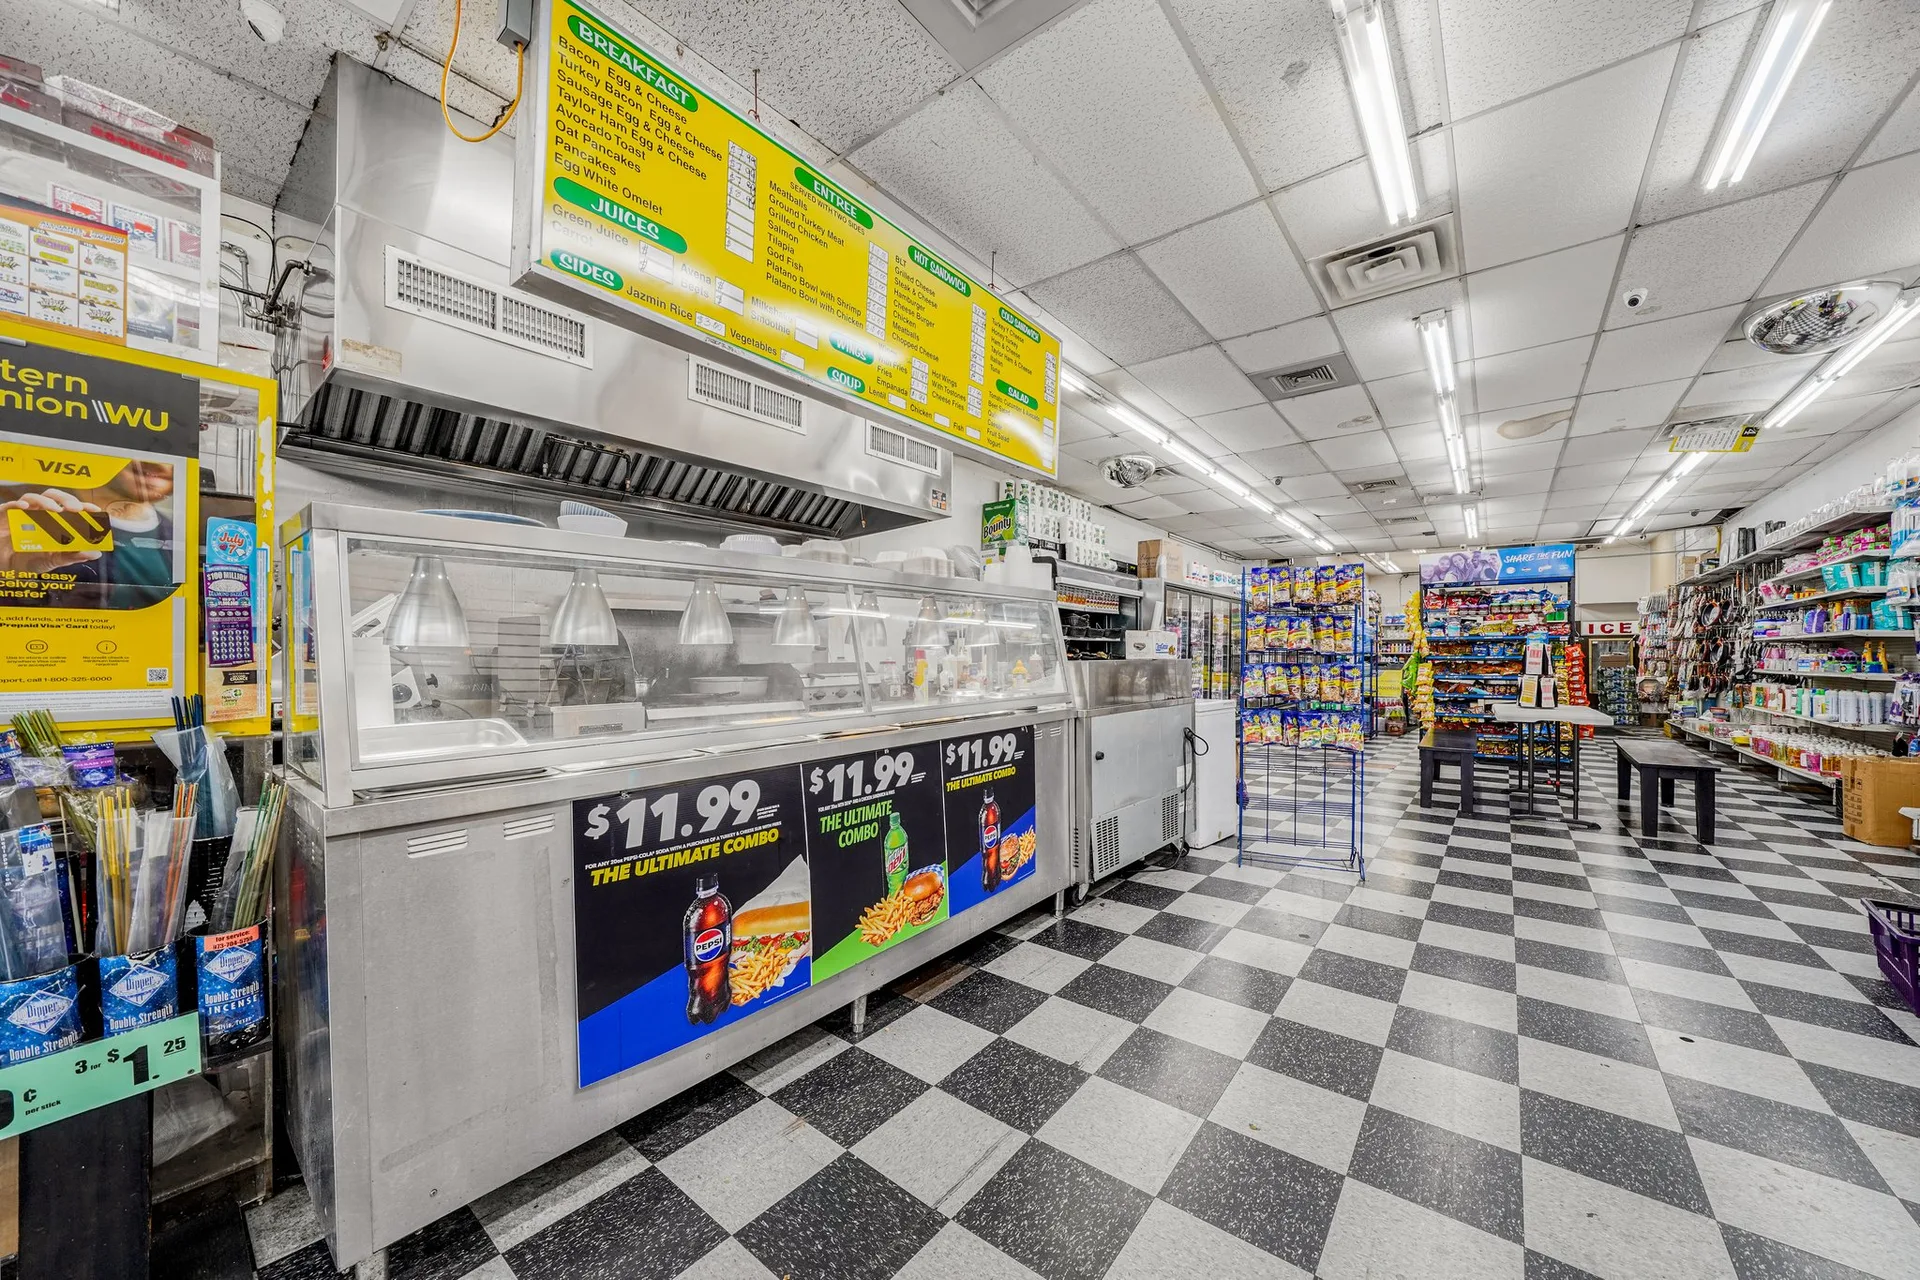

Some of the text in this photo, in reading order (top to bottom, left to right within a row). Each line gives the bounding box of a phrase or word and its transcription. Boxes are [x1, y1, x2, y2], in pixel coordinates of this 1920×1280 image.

[578, 22, 689, 105] BREAKFAST
[559, 36, 687, 124] Bacon Egg & Cheese
[557, 70, 695, 159] Sausage Egg & Cheese
[558, 52, 722, 161] Turkey Bacon Egg & Cheese
[556, 103, 646, 160] Avocado Toast
[557, 86, 707, 180] Taylor Ham Egg & Cheese
[555, 136, 616, 176] Pancakes
[556, 119, 641, 173] Oat Pancakes
[554, 152, 663, 215] Egg White Omelet
[769, 181, 808, 211] Meatballs
[790, 182, 865, 235] SERVED WITH TWO SIDES
[813, 180, 857, 218] ENTREE
[553, 204, 628, 245] Green Juice
[591, 198, 659, 240] JUICES
[768, 220, 799, 244] Salmon
[769, 194, 844, 246] Ground Turkey Meat
[769, 207, 829, 249] Grilled Chicken
[552, 220, 592, 246] Carrot
[767, 233, 795, 255] Tilapia
[559, 254, 614, 286] SIDES
[767, 247, 803, 272] God Fish
[895, 255, 907, 267] BLT
[914, 250, 966, 294] HOT SANDWICH
[767, 259, 861, 317] Platano Bowl with Shrimp
[894, 278, 910, 292] Steak
[918, 292, 937, 309] Cheese
[895, 267, 935, 297] Grilled Cheese
[627, 286, 692, 320] Jazmin Rice
[766, 272, 864, 329] Platano Bowl with Chicken
[893, 289, 925, 312] Hamburger
[751, 310, 790, 335] Smoothie
[893, 300, 935, 328] Cheese Burger
[893, 311, 916, 329] Chicken
[730, 328, 777, 355] Vegetables
[892, 321, 919, 341] Meatballs
[1010, 330, 1024, 344] Cheese
[892, 332, 918, 352] Chopped
[919, 346, 939, 363] Cheese
[1006, 346, 1020, 359] Cheese
[831, 370, 862, 390] SOUP
[877, 365, 892, 378] Fries
[932, 370, 957, 388] Hot Wings
[1018, 362, 1032, 375] Cheese
[868, 386, 886, 400] Lentil
[877, 377, 907, 396] Empanada
[932, 380, 965, 401] With Tostones
[1008, 387, 1029, 404] SALAD
[910, 404, 932, 419] Chicken
[932, 391, 951, 406] Cheese
[952, 400, 964, 411] Fries
[104, 402, 169, 432] WU
[953, 422, 964, 432] Fish
[987, 438, 1000, 448] Yogurt
[33, 458, 91, 477] VISA
[219, 533, 244, 546] July
[983, 517, 1012, 539] Bounty
[228, 544, 236, 554] 7
[1503, 549, 1573, 564] SHARE FUN
[19, 571, 37, 579] an
[41, 572, 77, 582] easy
[41, 582, 75, 590] your
[1588, 622, 1632, 634] ICE
[946, 733, 1017, 772] $11.99
[809, 751, 914, 802] $11.99
[946, 780, 960, 792] THE
[961, 772, 993, 788] ULTIMATE
[993, 766, 1016, 780] COMBO
[584, 779, 761, 849] $11.99
[820, 813, 842, 834] THE
[844, 799, 892, 827] ULTIMATE
[838, 822, 879, 848] COMBO
[585, 862, 597, 870] FOR
[598, 860, 610, 868] ANY
[656, 848, 670, 856] SODA
[687, 838, 710, 848] PURCHASE
[590, 828, 779, 886] THE ULTIMATE COMBO
[696, 937, 722, 951] PEPSI
[126, 976, 154, 991] Dipper
[205, 981, 260, 1004] Double Strength
[27, 1002, 58, 1018] Dipper
[110, 1004, 173, 1030] Double Strength
[208, 995, 257, 1015] INCENSE
[9, 1030, 79, 1061] Double Strength
[75, 1060, 88, 1075] 3
[90, 1062, 102, 1071] for
[25, 1100, 61, 1116] per stick
